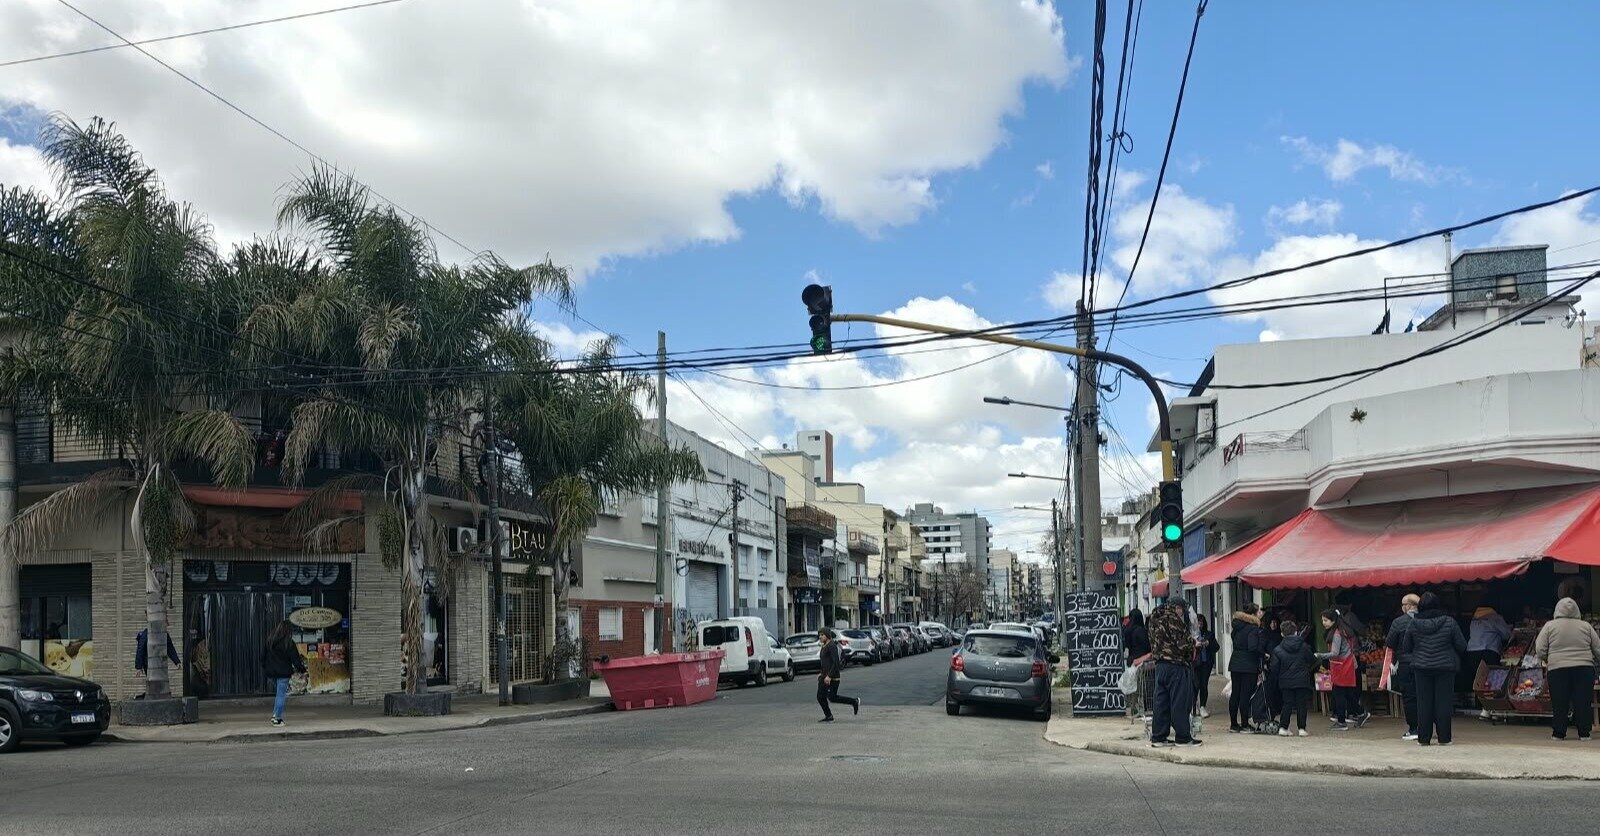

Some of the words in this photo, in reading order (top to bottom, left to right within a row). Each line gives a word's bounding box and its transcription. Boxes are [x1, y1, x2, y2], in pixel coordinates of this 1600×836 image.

[1066, 593, 1078, 612] 3
[1092, 592, 1117, 610] 2000
[1067, 614, 1078, 632] 3
[1092, 614, 1117, 629] 3500
[1071, 632, 1079, 650] 1
[1092, 631, 1119, 649] 6000
[1071, 651, 1081, 669] 3
[1097, 651, 1121, 667] 6000
[1072, 671, 1082, 687] 2
[1073, 689, 1087, 709] 2
[1101, 689, 1126, 709] 7000
